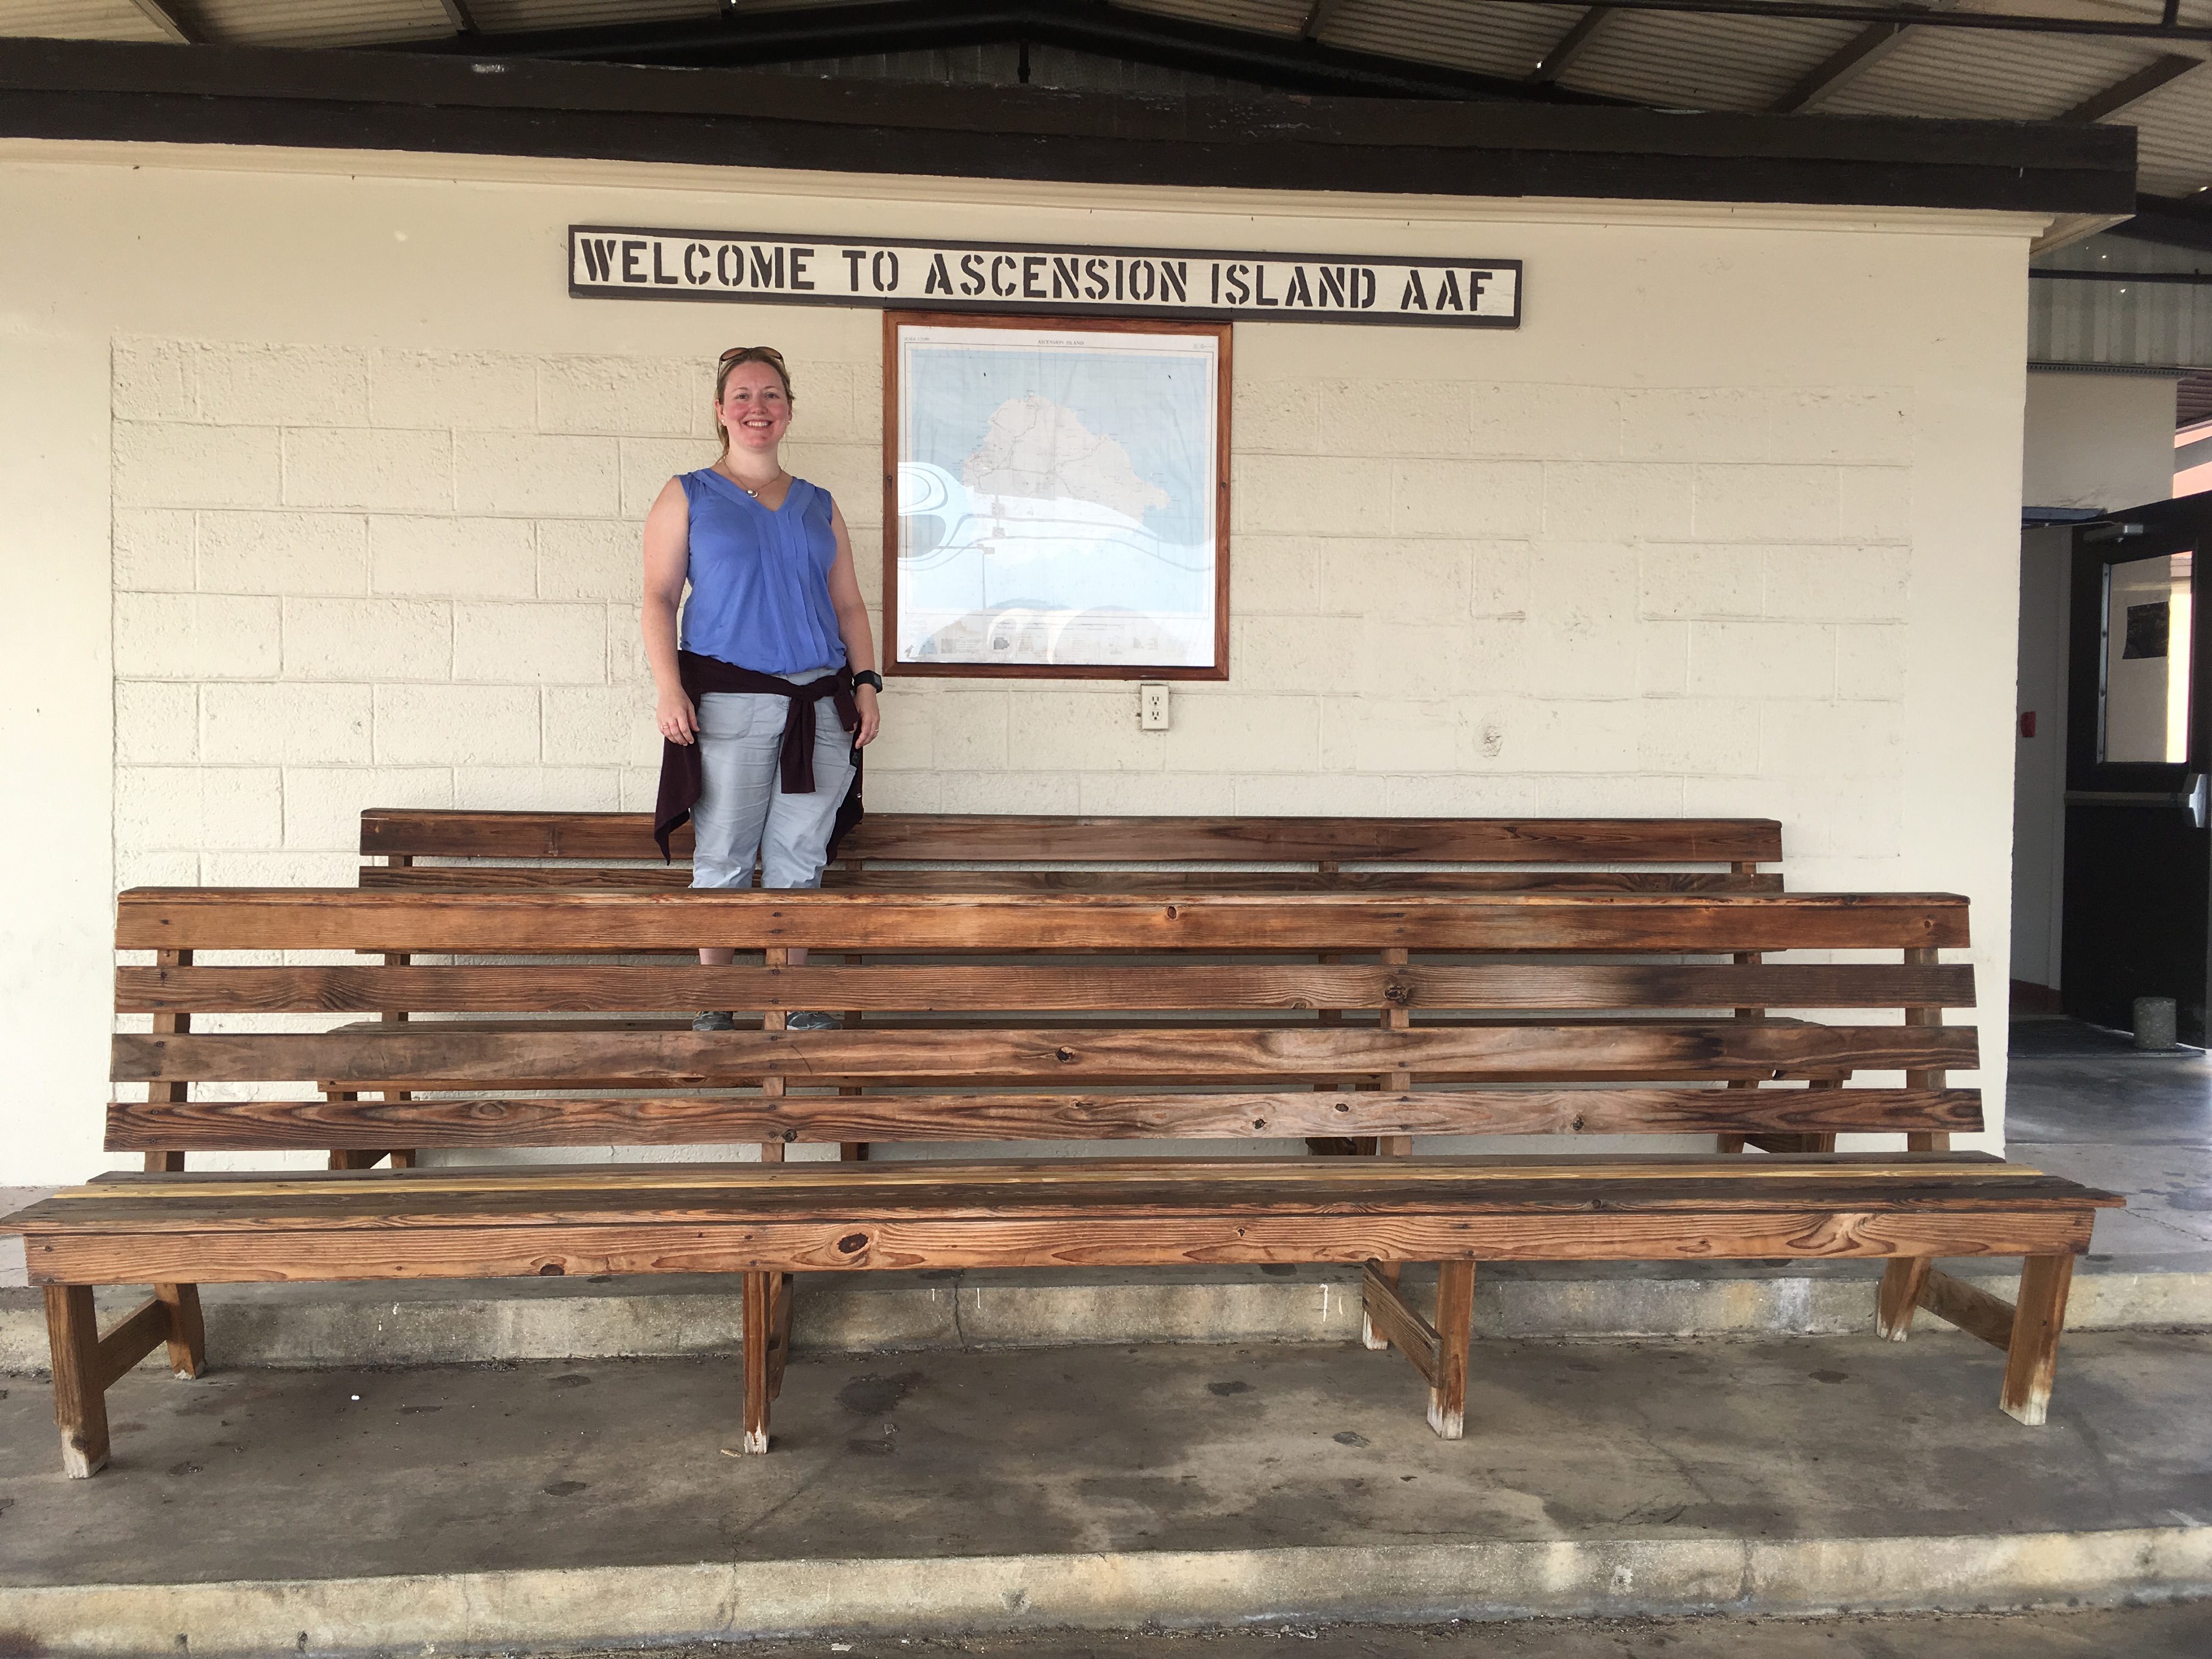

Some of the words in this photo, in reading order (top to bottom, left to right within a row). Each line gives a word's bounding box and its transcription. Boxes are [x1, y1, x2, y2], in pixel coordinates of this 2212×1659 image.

[580, 239, 815, 290] WELCOME
[842, 250, 899, 292] TO
[924, 254, 1187, 302] ASCENSION
[1211, 264, 1376, 309] ISLAND
[1400, 270, 1493, 312] AAF
